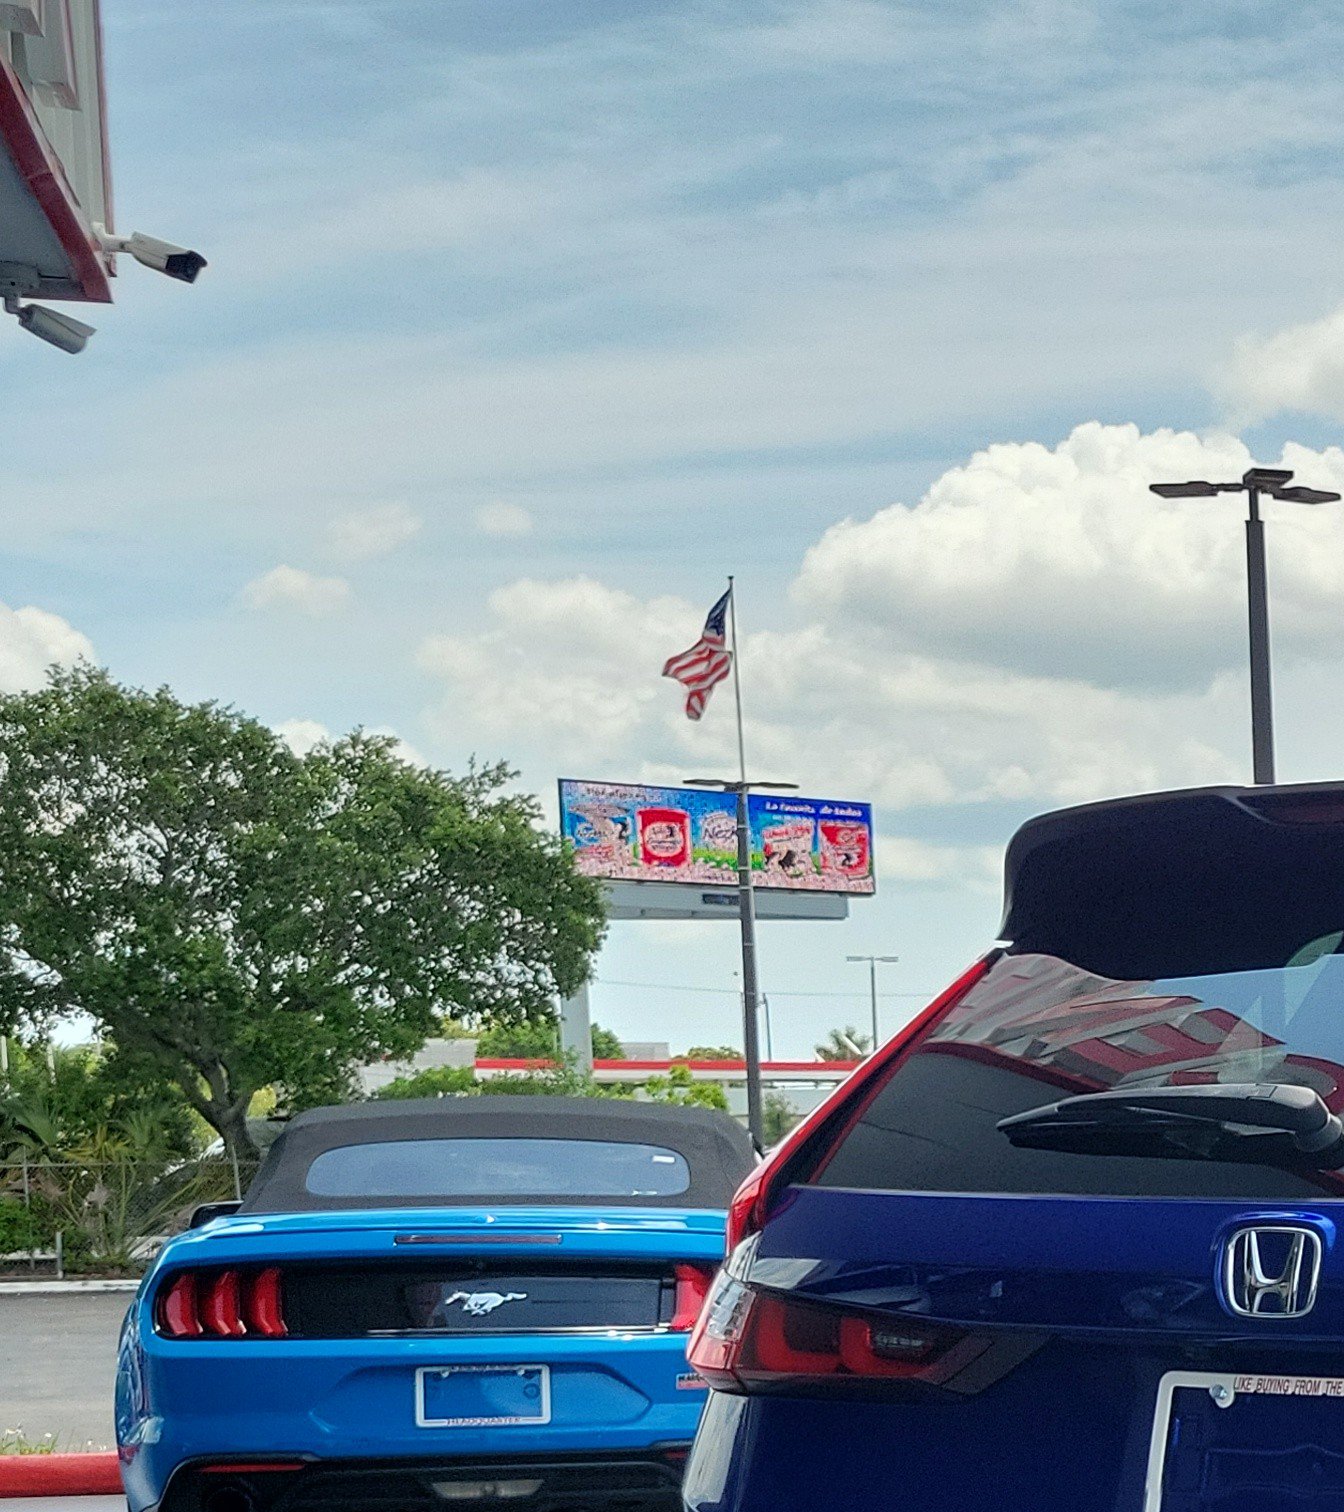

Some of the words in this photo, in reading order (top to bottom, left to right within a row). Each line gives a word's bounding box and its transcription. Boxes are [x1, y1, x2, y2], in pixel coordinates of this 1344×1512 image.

[1233, 1376, 1252, 1391] LIKE
[1256, 1377, 1290, 1393] BUYING
[1294, 1378, 1321, 1394] FROM
[1325, 1380, 1343, 1395] THE
